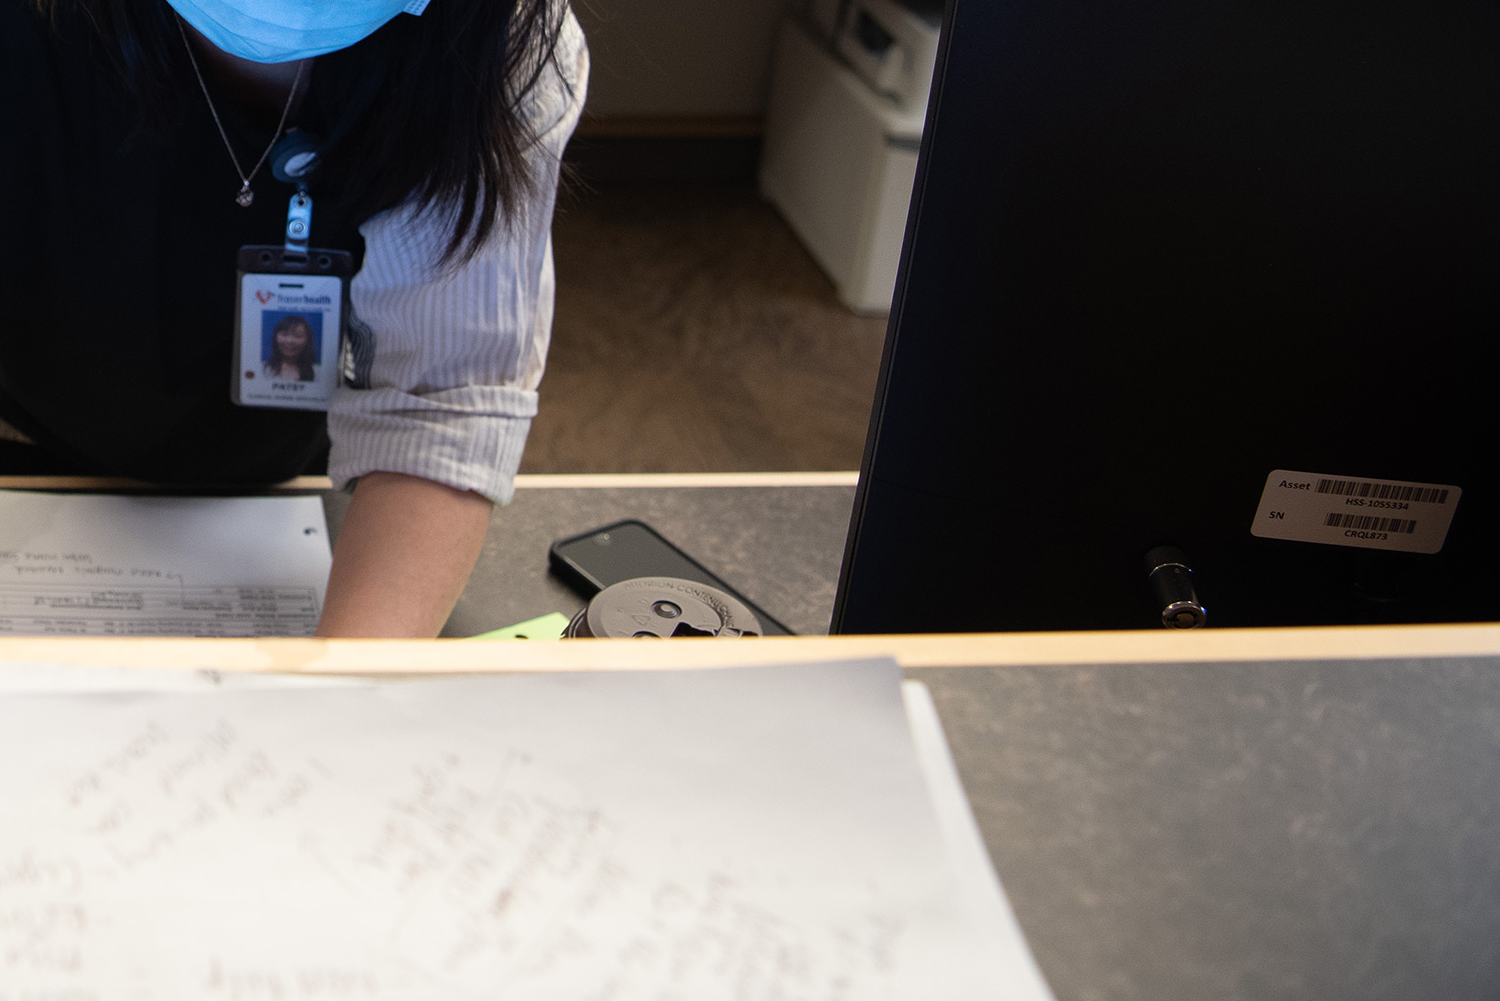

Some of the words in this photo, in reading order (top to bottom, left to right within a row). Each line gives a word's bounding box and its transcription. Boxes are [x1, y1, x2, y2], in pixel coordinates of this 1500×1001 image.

[1278, 480, 1311, 490] Asset
[1345, 498, 1409, 510] HSS-1055334
[1268, 511, 1285, 520] SN
[1344, 530, 1388, 540] CRQL873
